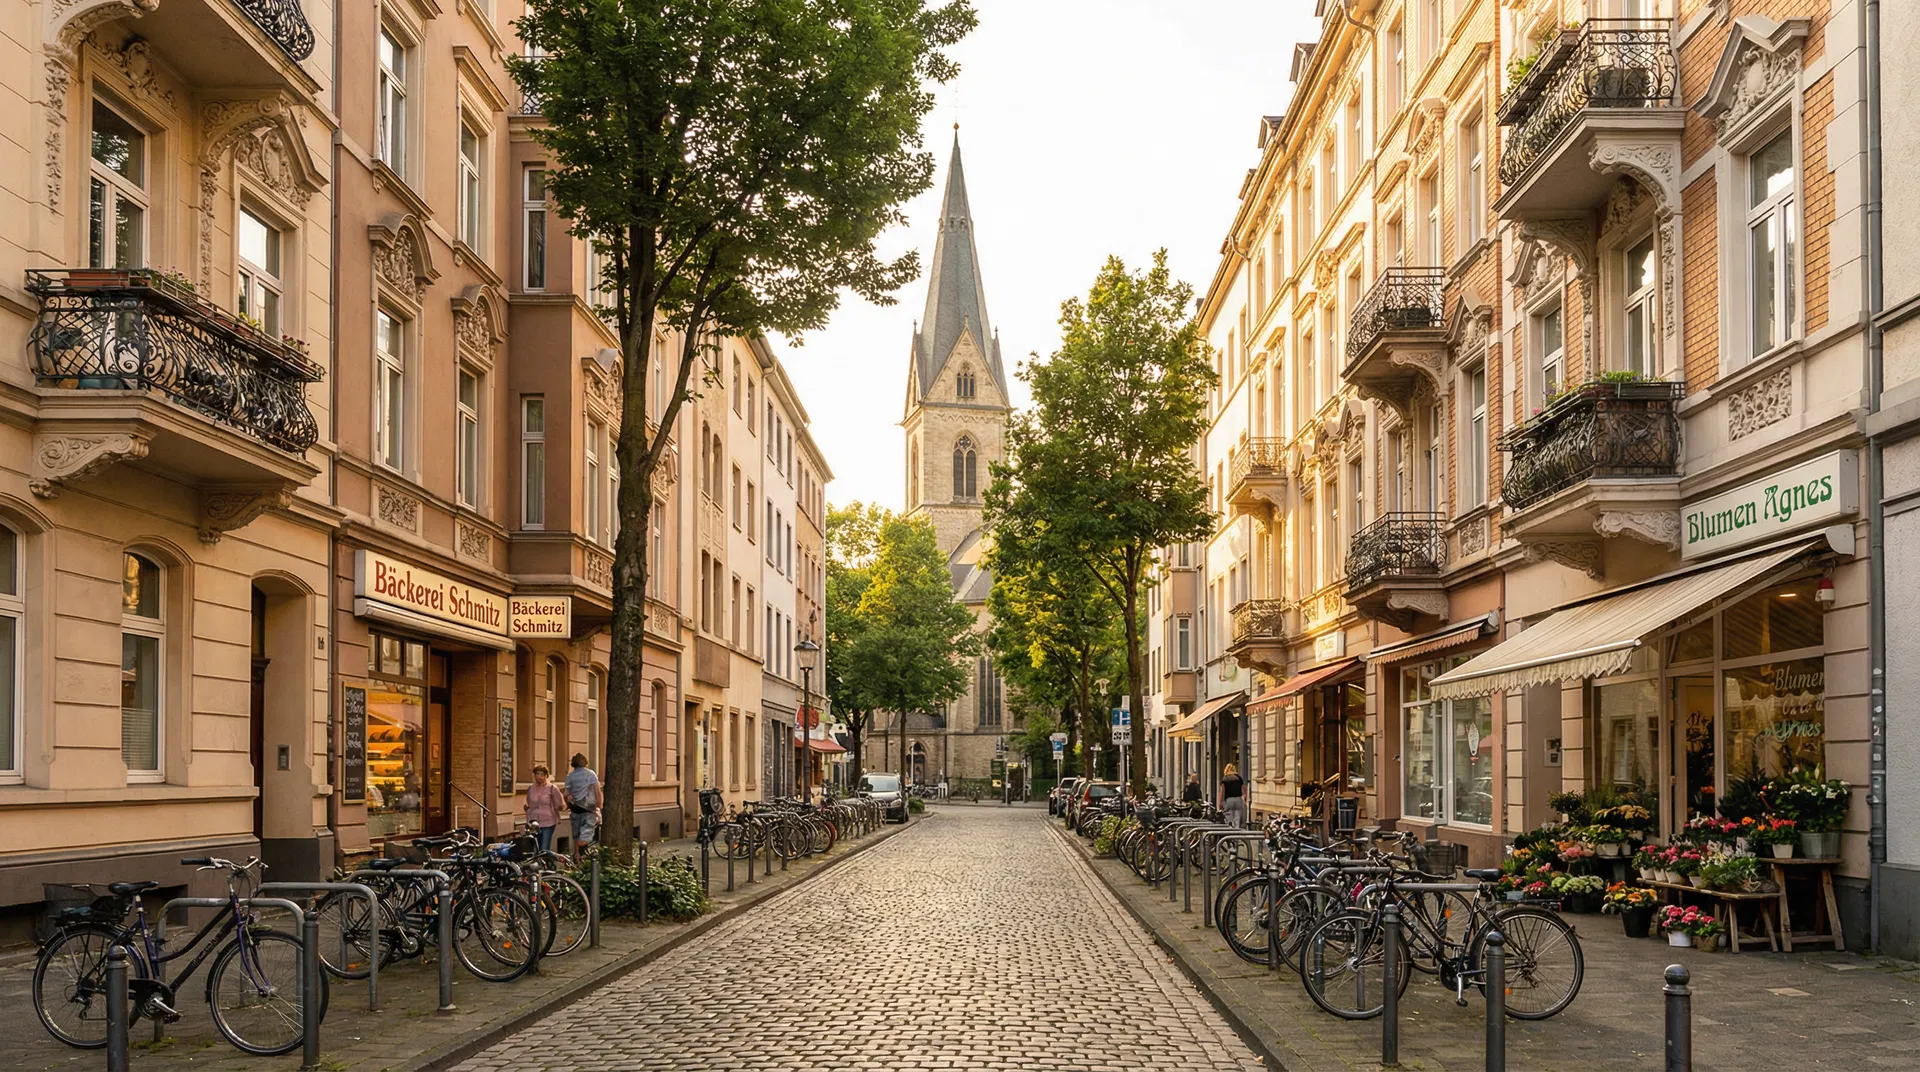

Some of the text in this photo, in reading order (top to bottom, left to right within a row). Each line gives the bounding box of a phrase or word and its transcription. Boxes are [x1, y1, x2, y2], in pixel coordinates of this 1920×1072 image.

[1687, 475, 1833, 544] Blumen Agnes
[374, 560, 501, 628] Bäckerei Schmitz
[511, 601, 566, 616] Bäckerei
[512, 619, 563, 633] Schmitz
